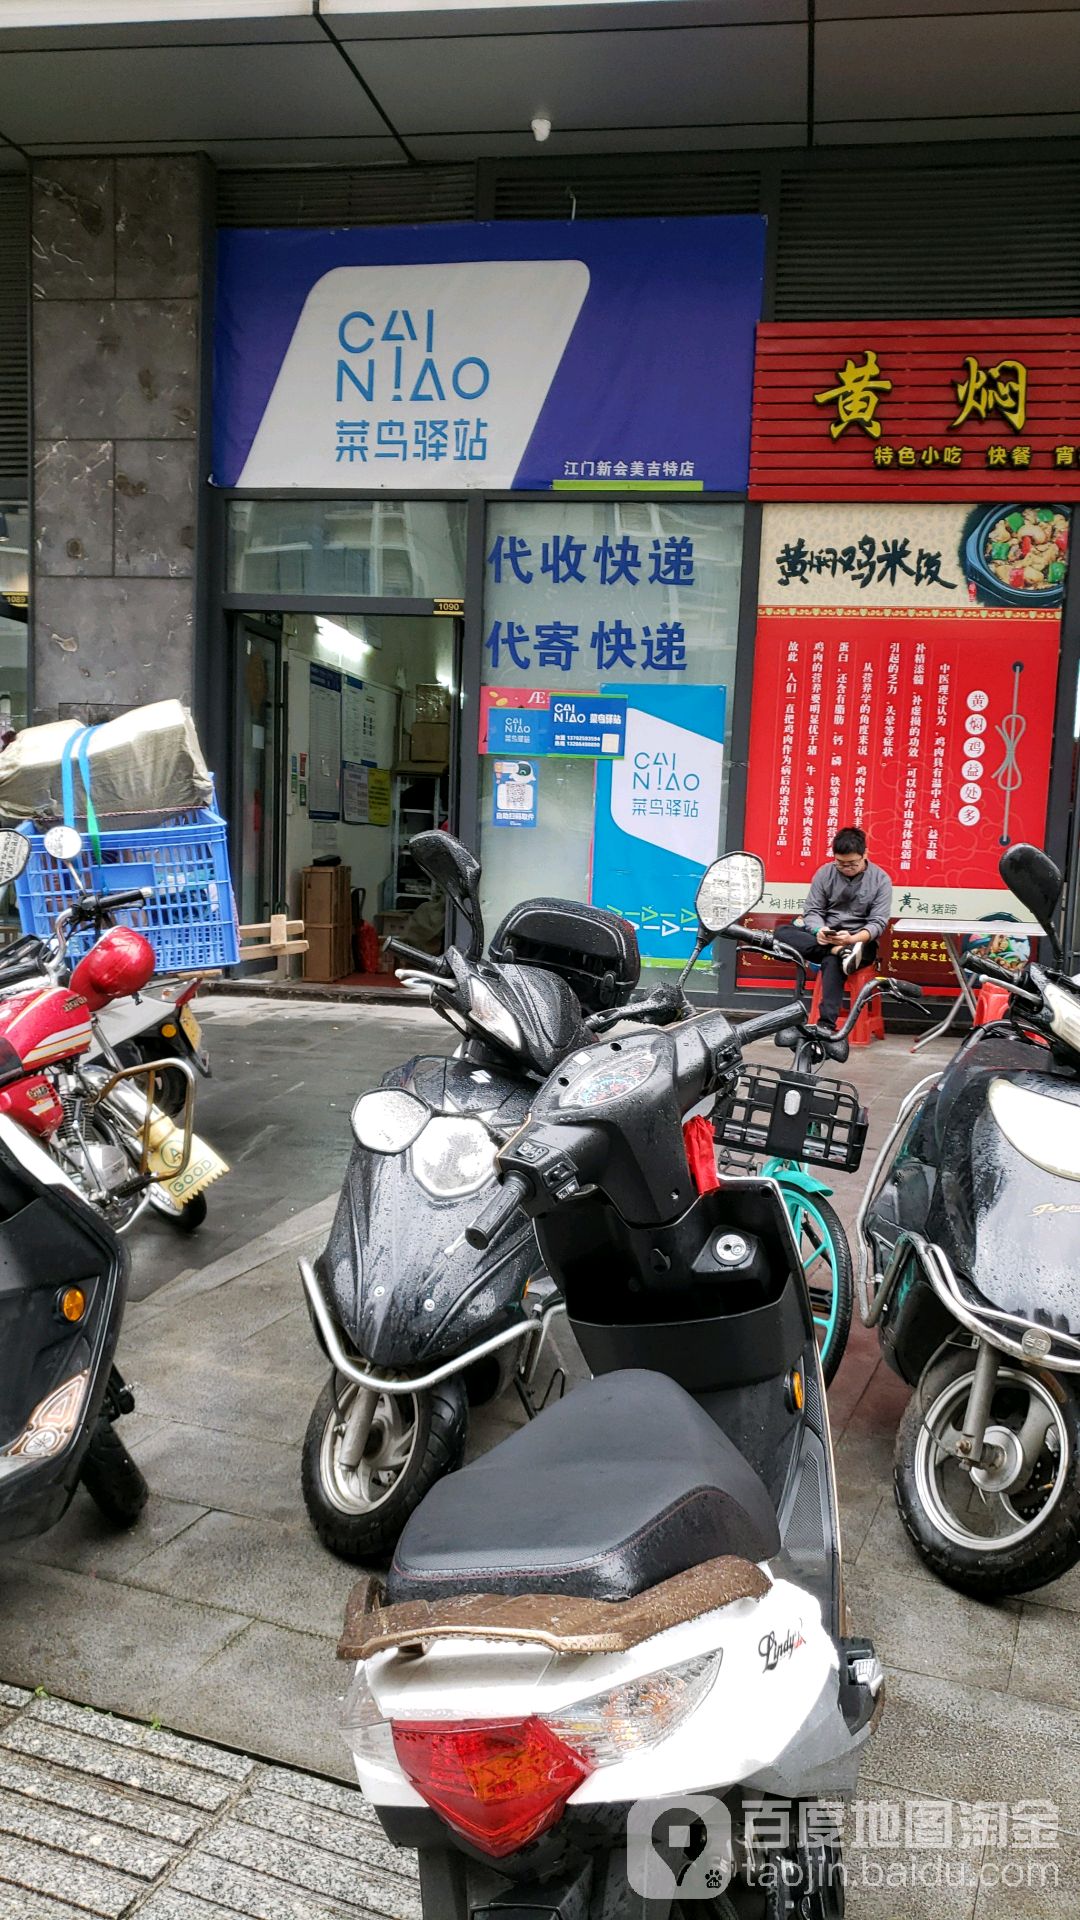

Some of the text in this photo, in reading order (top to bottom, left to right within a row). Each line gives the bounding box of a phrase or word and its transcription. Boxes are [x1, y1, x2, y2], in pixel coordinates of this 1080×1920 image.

[338, 309, 434, 354] CAI
[335, 418, 489, 463] 菜鸟驿站
[563, 460, 696, 478] 江门新会美吉特店
[874, 446, 963, 465] 特色小吃
[987, 445, 1032, 465] 快餐
[486, 534, 696, 587] 代收快递
[775, 534, 958, 590] 黄焖鸡米饭
[438, 602, 460, 611] 1090
[484, 619, 689, 672] 代寄快递
[554, 703, 575, 714] CAI
[633, 751, 677, 771] CAI
[962, 694, 986, 823] 黄焖鸡益处多
[631, 798, 700, 819] 菜鸟驿站
[898, 892, 958, 915] 黄焖猪蹄
[173, 1159, 212, 1192] GOOD
